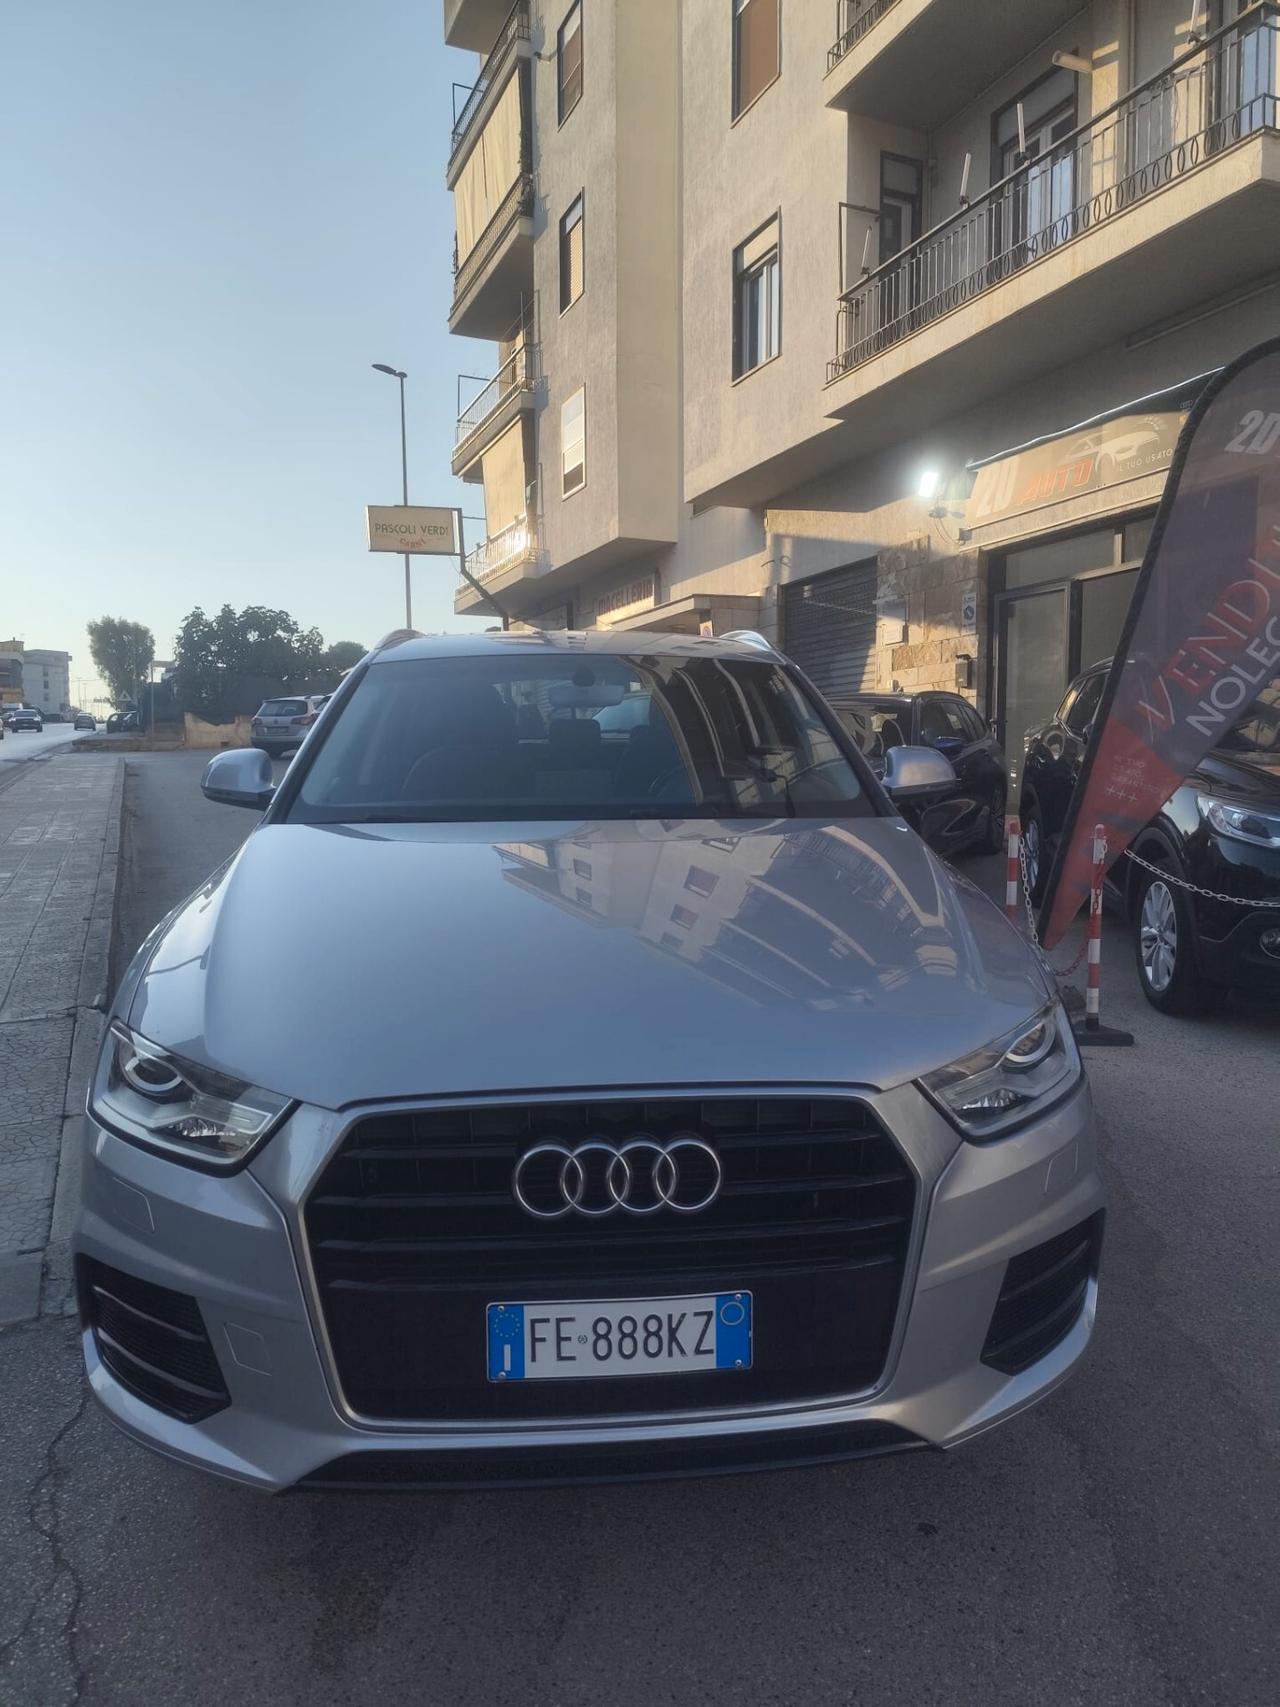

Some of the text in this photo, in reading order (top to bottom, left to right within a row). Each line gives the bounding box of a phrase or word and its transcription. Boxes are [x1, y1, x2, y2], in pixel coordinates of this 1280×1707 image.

[1127, 458, 1143, 470] TUO
[1145, 447, 1174, 464] USATO
[375, 523, 449, 536] PASCOLI VERDI
